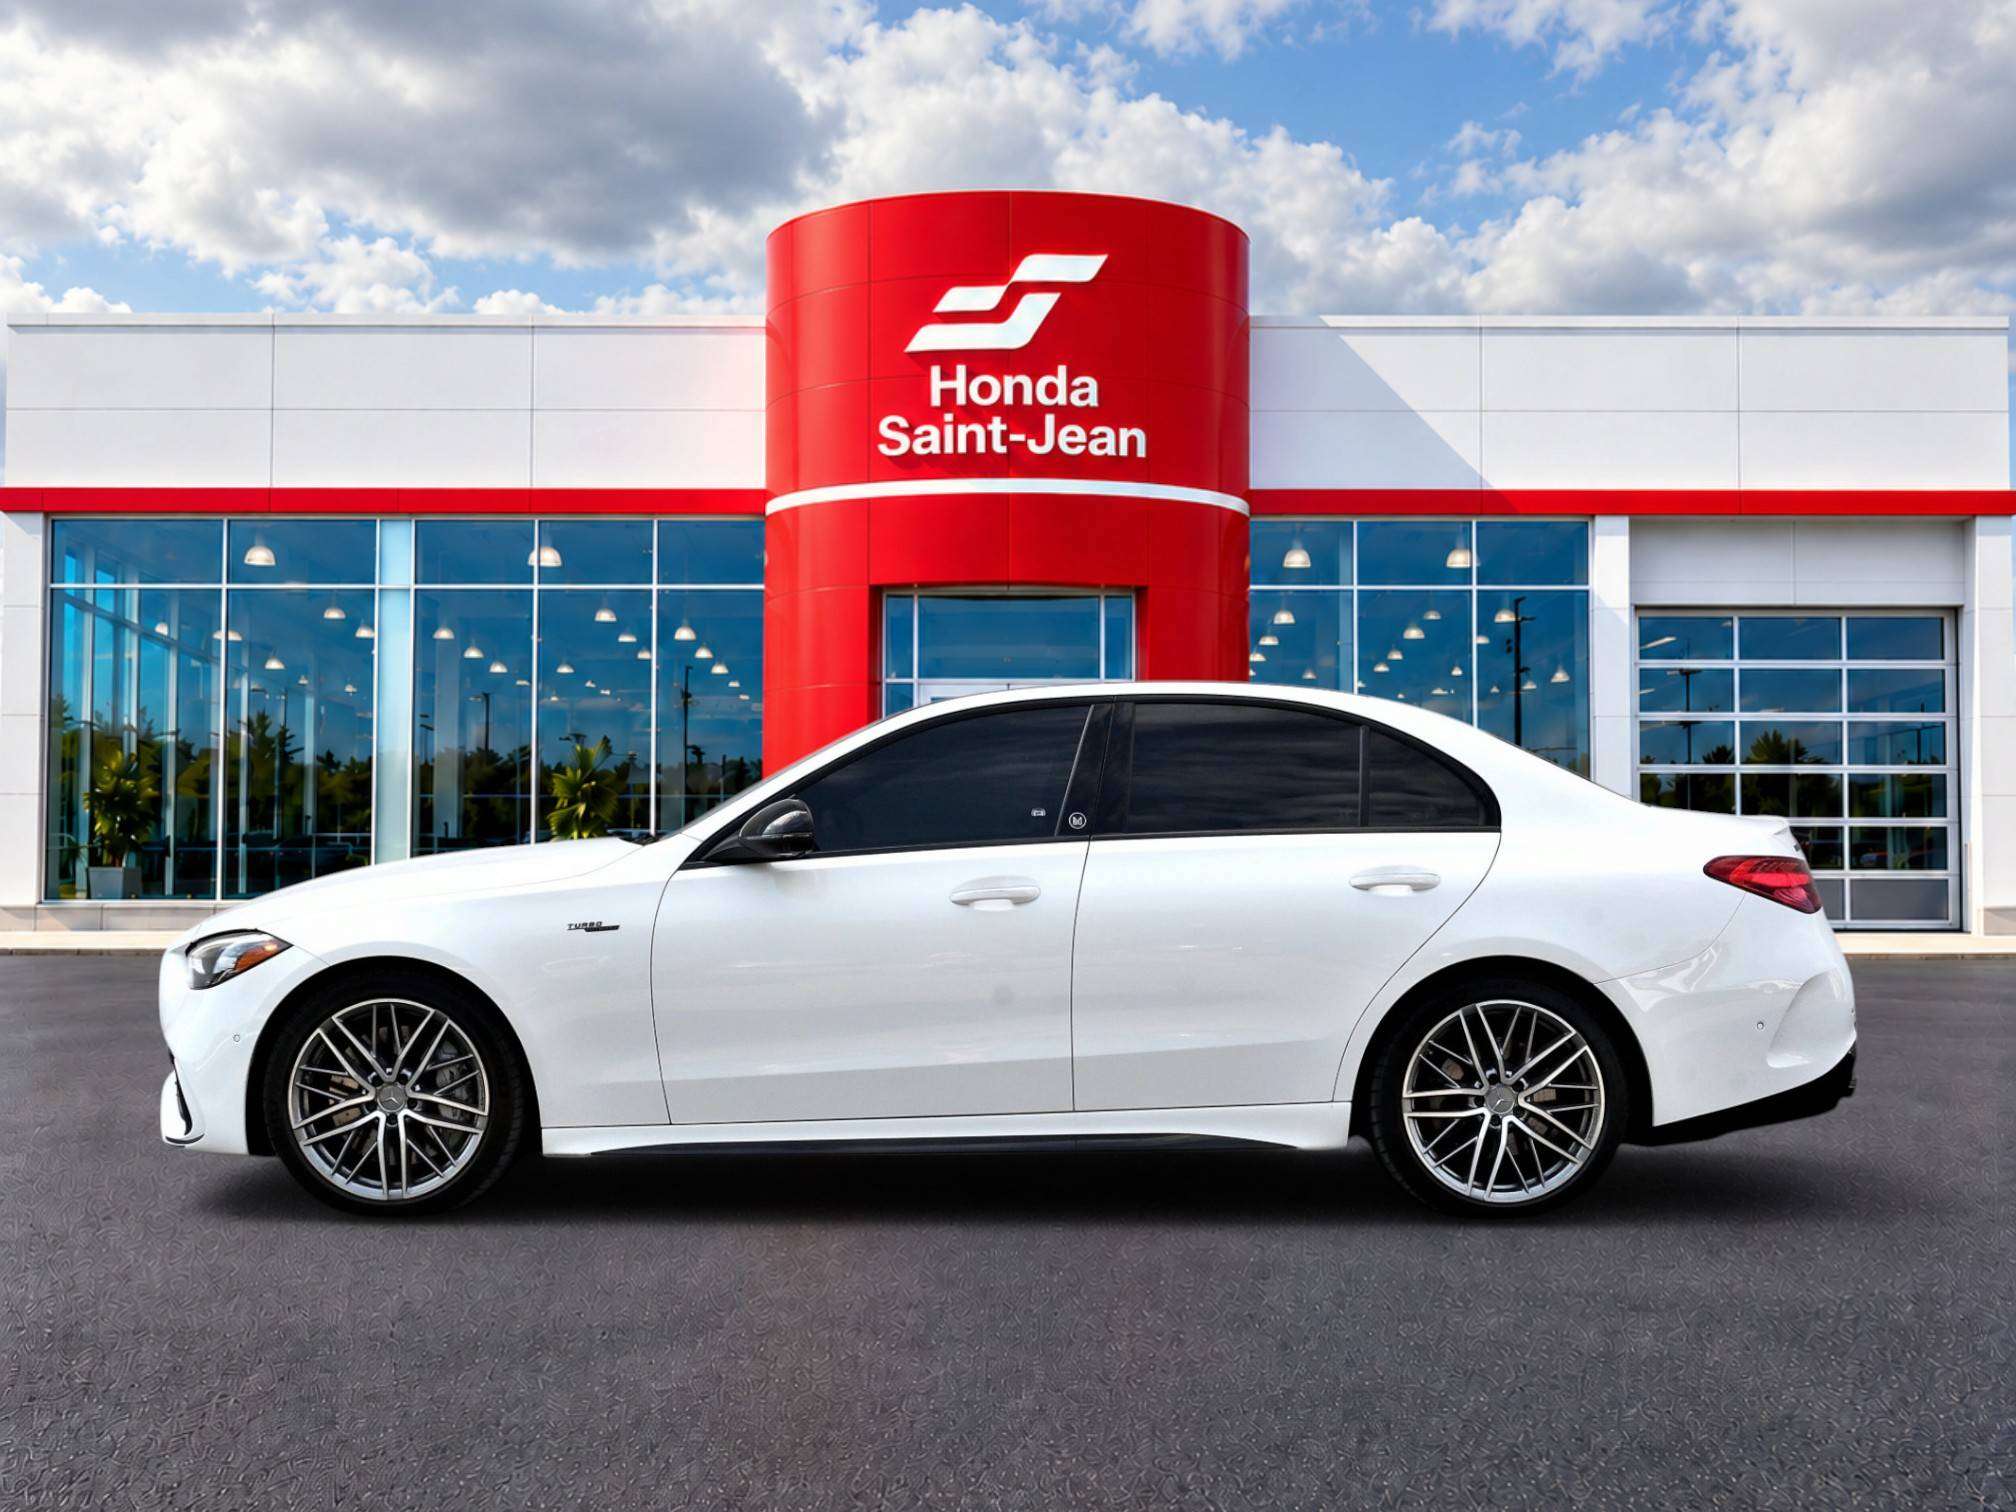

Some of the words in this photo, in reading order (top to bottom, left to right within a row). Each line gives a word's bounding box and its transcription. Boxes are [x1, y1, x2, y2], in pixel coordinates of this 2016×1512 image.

[930, 364, 1099, 407] Honda
[877, 412, 1147, 458] Saint-Jean
[567, 920, 603, 930] TURBO
